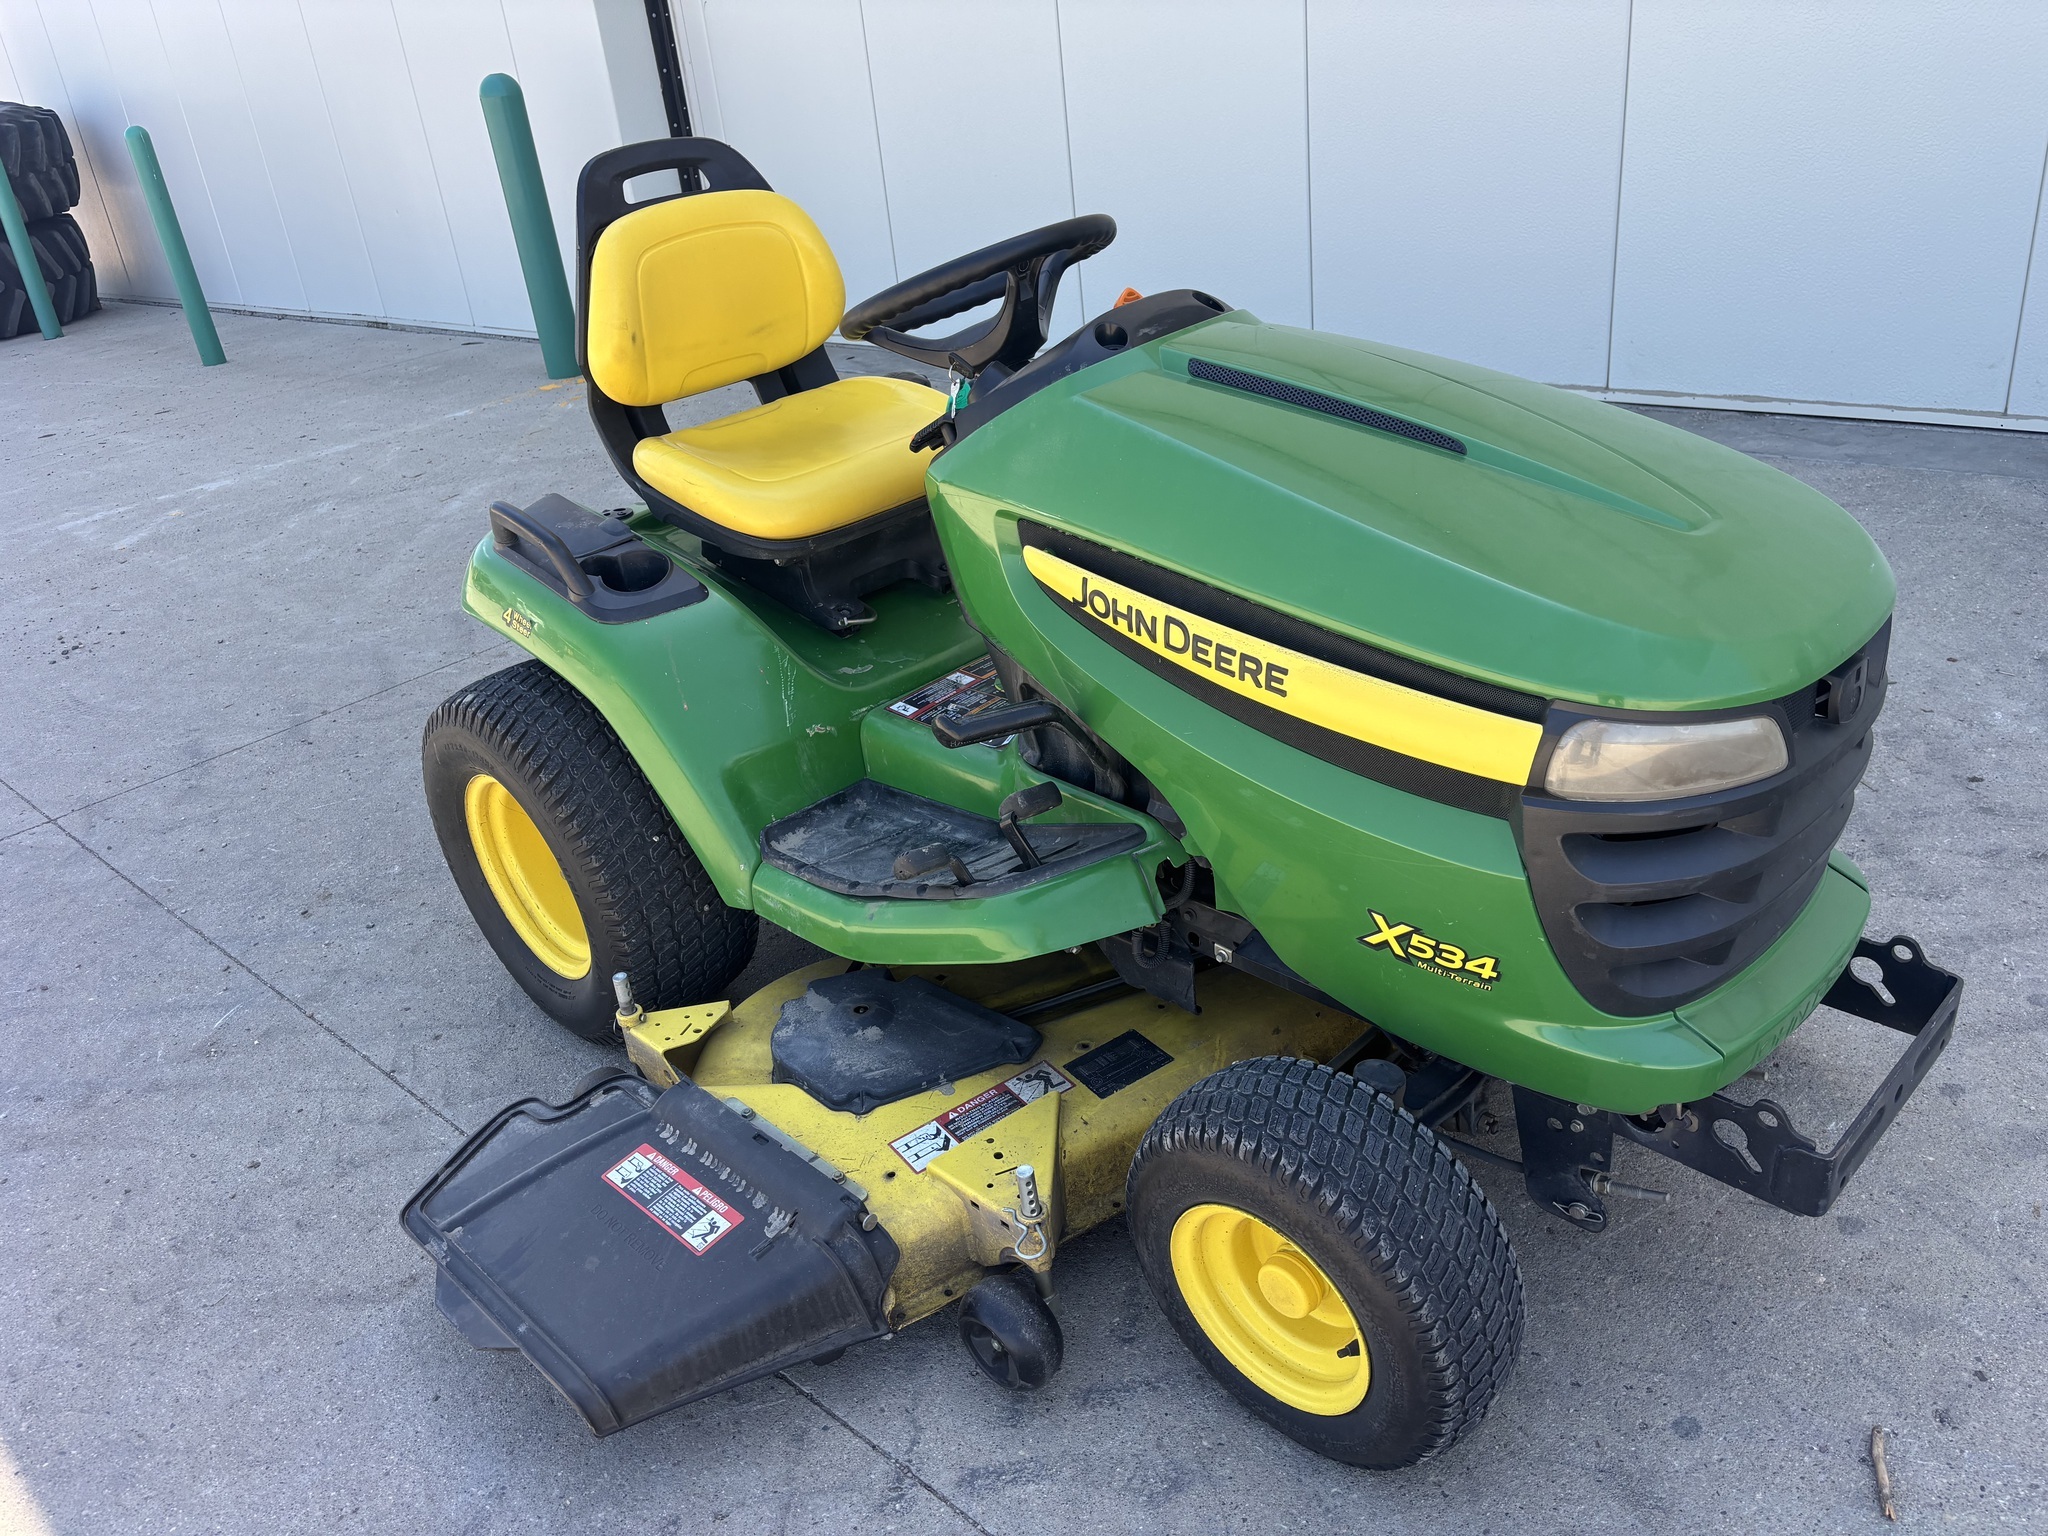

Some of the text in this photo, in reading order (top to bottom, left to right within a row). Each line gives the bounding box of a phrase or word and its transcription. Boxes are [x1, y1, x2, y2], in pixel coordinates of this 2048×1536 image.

[502, 607, 532, 630] 4 Whee
[512, 620, 531, 638] Steer
[1072, 576, 1289, 698] JOHN DEERE
[1358, 909, 1500, 981] X534
[1417, 960, 1493, 992] Multi-Terrain
[956, 1089, 998, 1114] DANGER
[653, 1155, 680, 1176] DANGER
[699, 1190, 729, 1214] PELIGRO
[590, 1203, 665, 1271] DO NOT REMOVE
